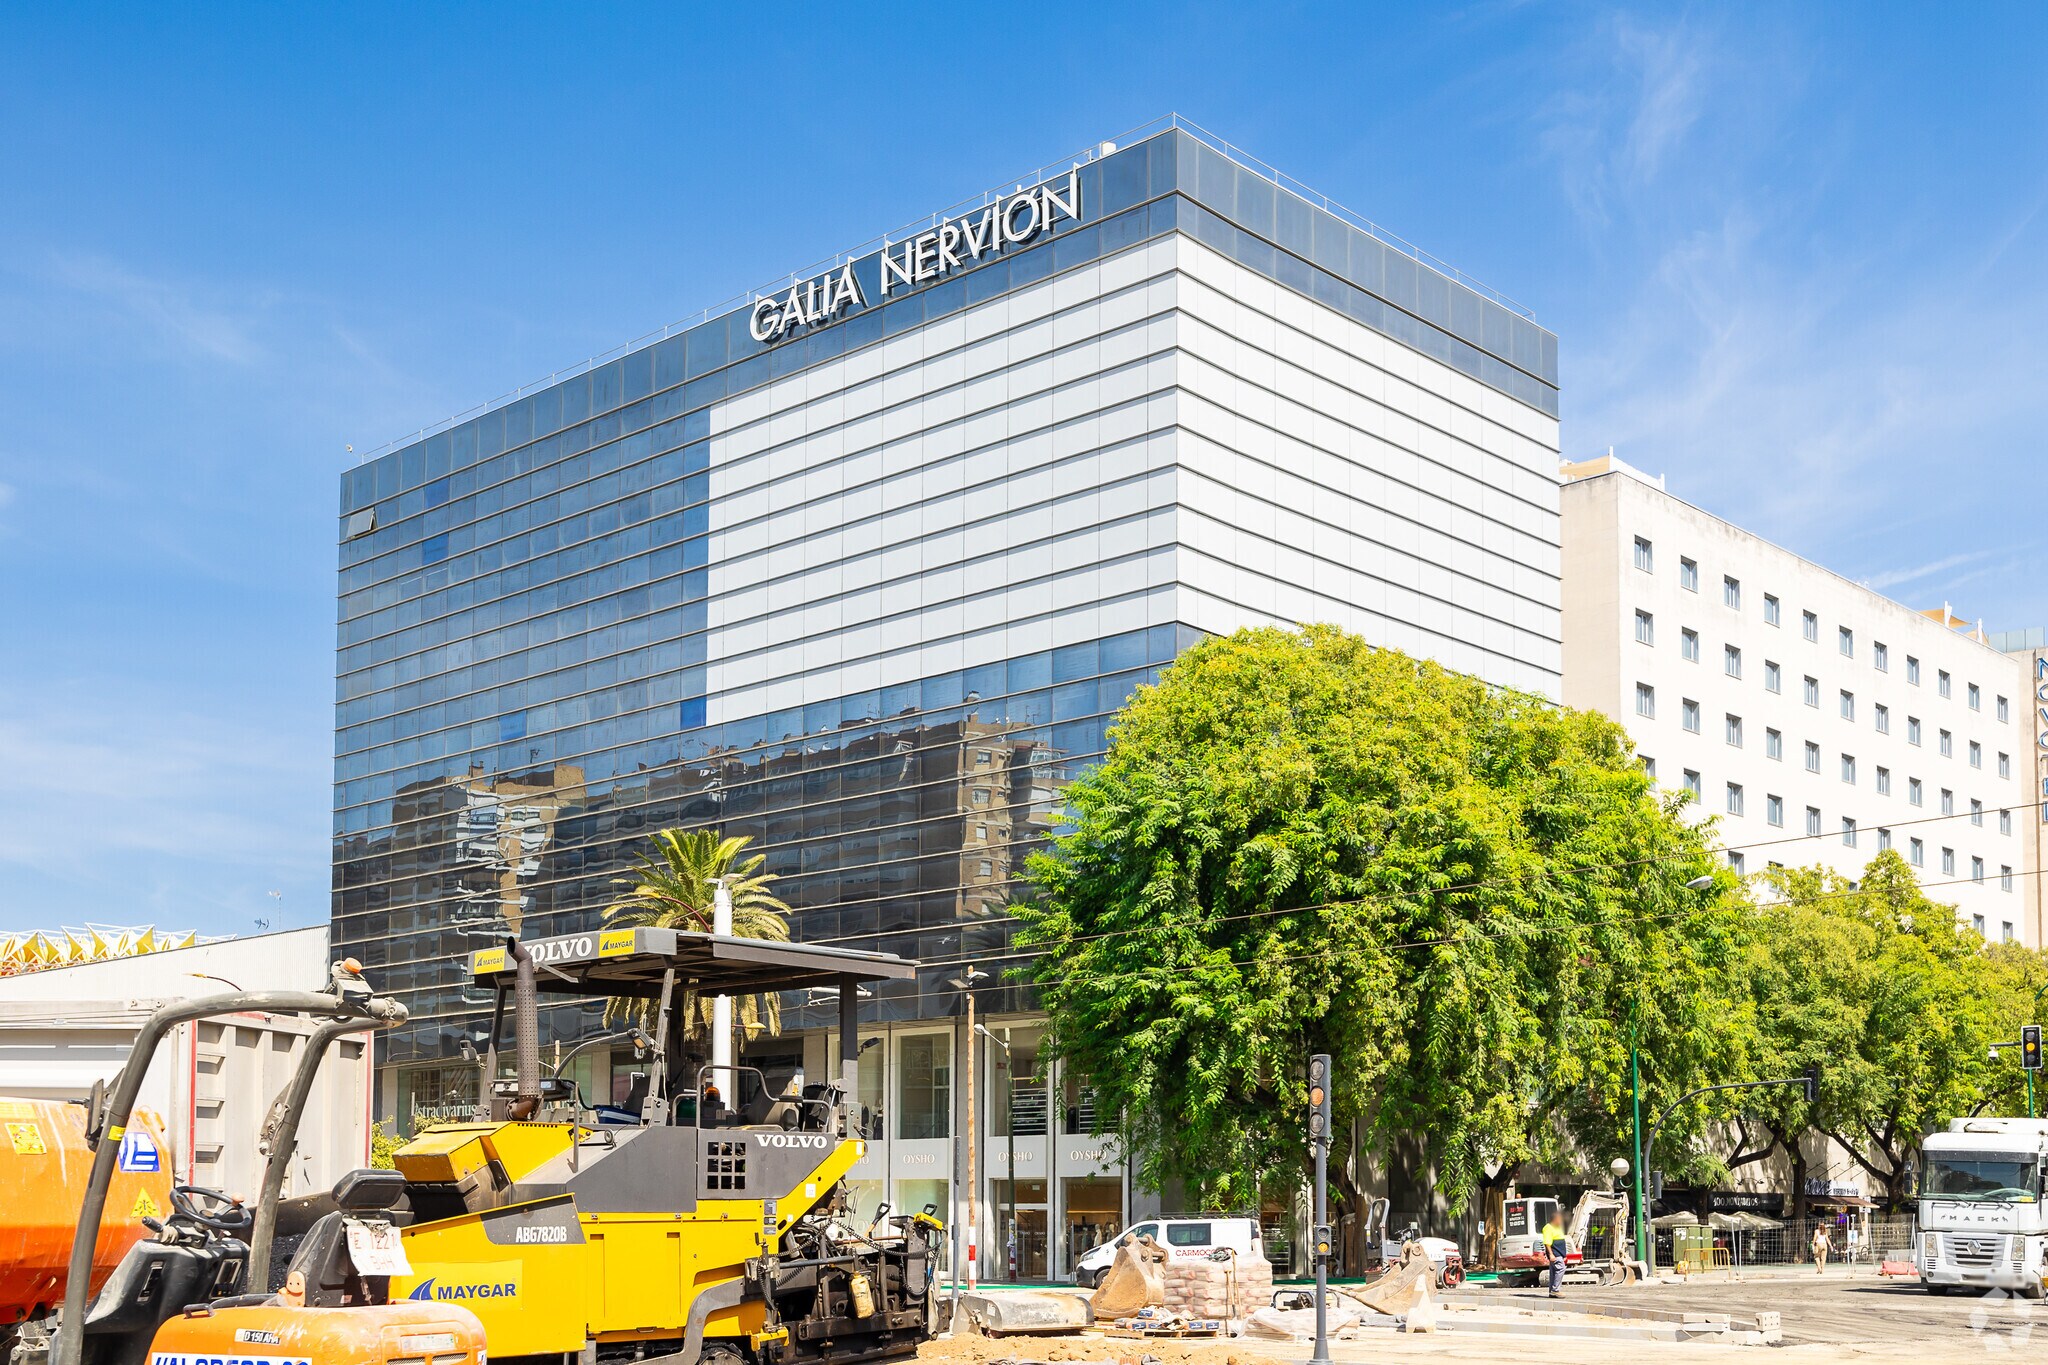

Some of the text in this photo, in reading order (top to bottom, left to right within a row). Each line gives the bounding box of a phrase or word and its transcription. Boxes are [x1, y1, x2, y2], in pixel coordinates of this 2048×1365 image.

[750, 173, 1079, 342] GALIA NERVIÓN
[609, 940, 633, 949] MAYGAR
[755, 1134, 827, 1148] VOLVO
[903, 1154, 935, 1164] OYSHO
[1070, 1150, 1107, 1161] OYSHO
[515, 1227, 567, 1243] ABG7820B
[438, 1283, 516, 1300] MAYGAR
